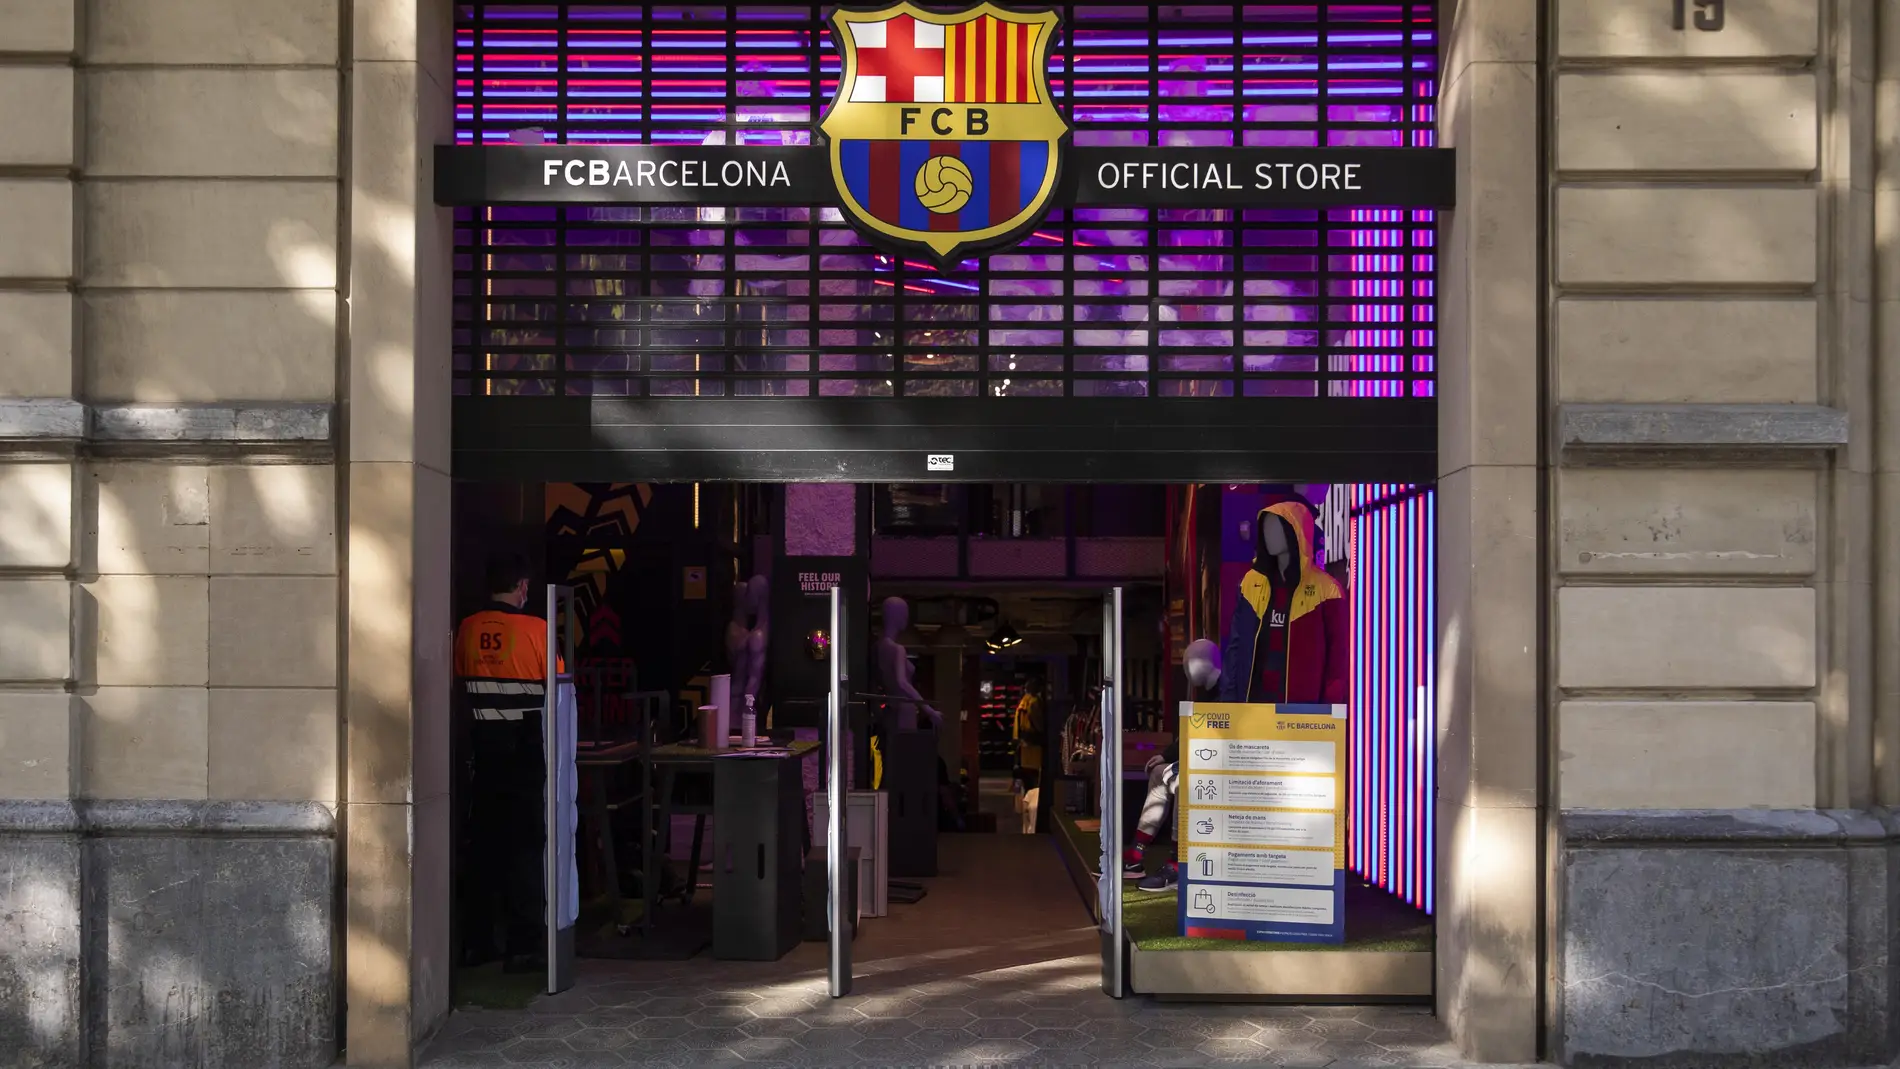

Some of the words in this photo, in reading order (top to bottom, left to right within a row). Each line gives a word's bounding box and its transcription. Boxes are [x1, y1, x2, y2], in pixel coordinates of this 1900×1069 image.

[900, 108, 989, 135] FCB
[543, 159, 790, 187] FCBARCELONA
[1097, 162, 1243, 190] OFFICIAL
[1254, 163, 1362, 190] STORE
[798, 572, 819, 582] FEEL
[821, 572, 841, 582] OUR
[480, 632, 502, 650] BS
[1207, 721, 1230, 729] FREE
